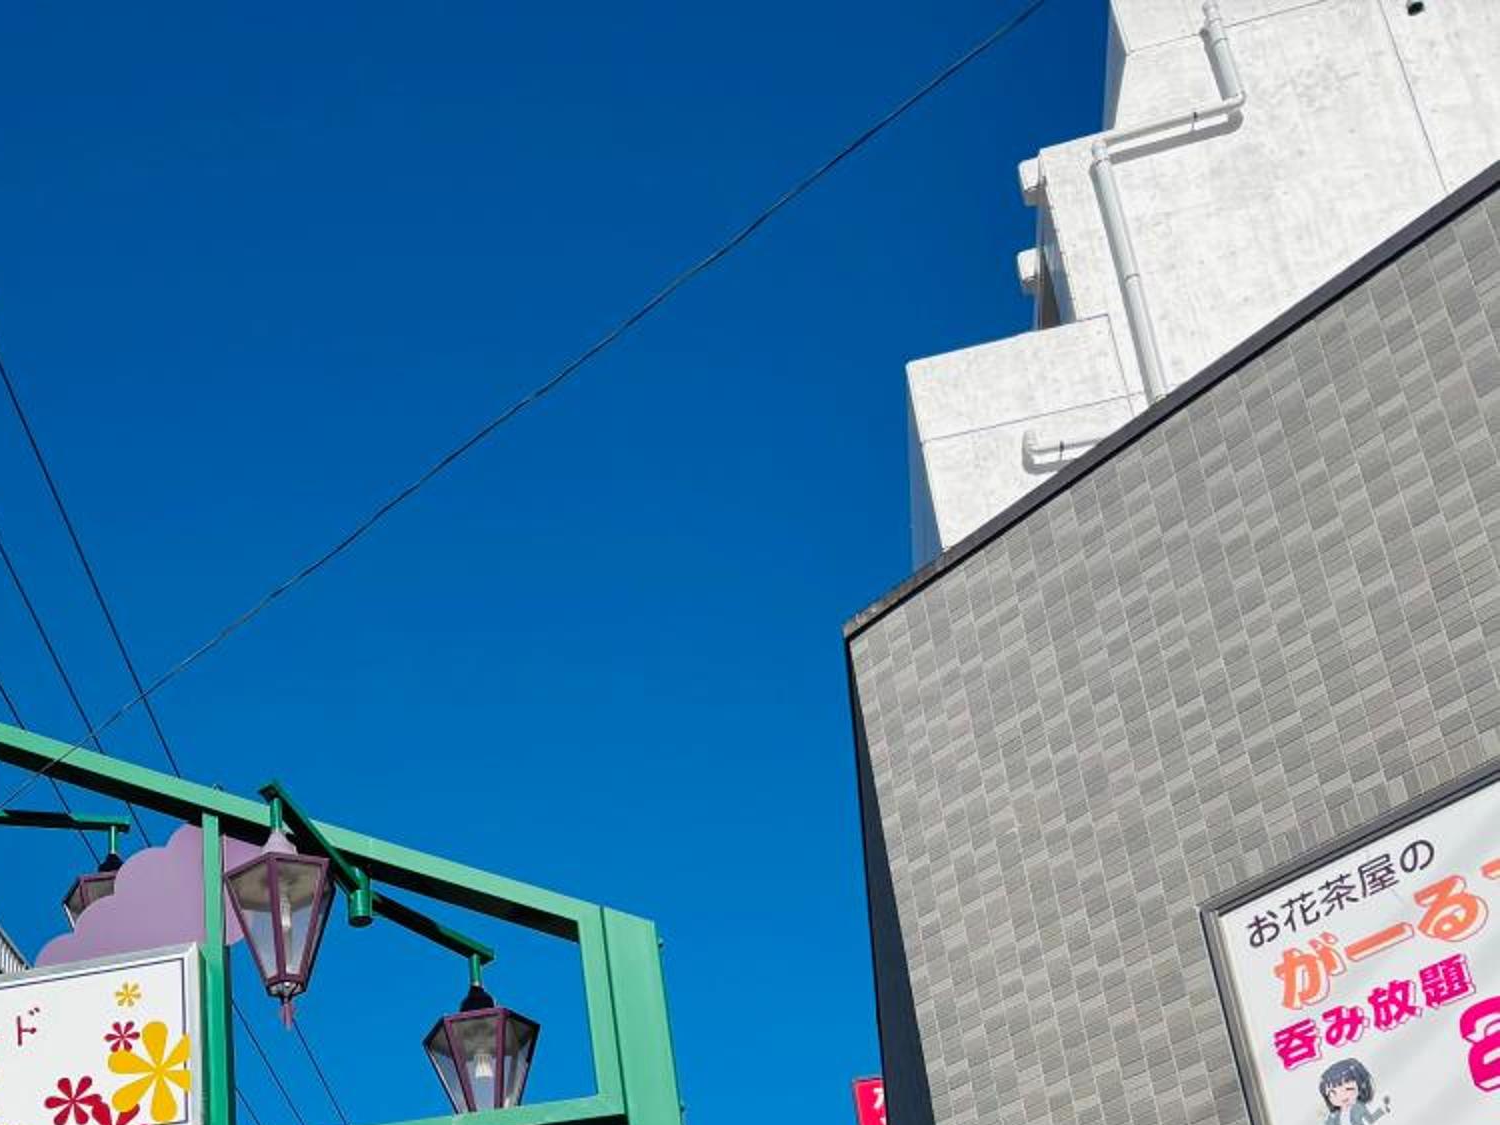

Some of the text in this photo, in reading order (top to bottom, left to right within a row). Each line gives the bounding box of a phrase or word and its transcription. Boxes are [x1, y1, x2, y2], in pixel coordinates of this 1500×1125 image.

[1246, 838, 1436, 948] お花茶屋の
[1273, 852, 1500, 1010] がーる
[1273, 953, 1477, 1070] 呑み放題
